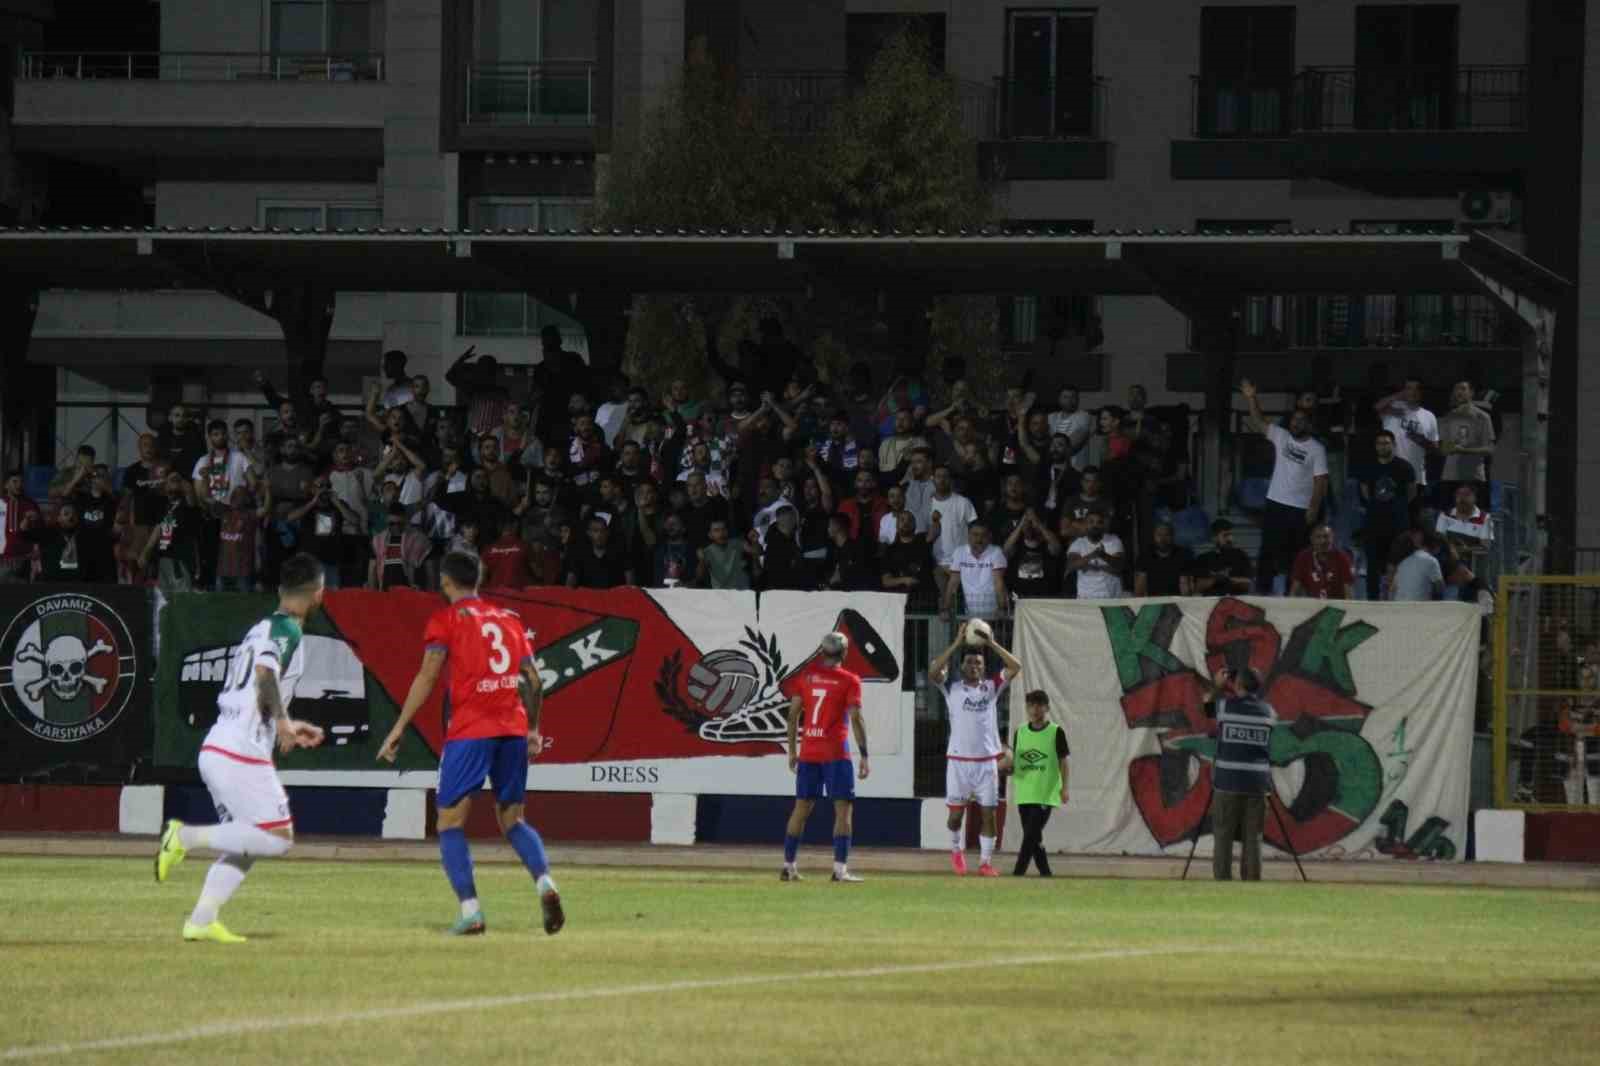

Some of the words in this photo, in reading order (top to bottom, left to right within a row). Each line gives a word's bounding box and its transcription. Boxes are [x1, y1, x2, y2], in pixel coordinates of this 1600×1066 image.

[481, 621, 511, 675] 3
[812, 688, 828, 725] 7
[592, 765, 659, 784] DRESS
